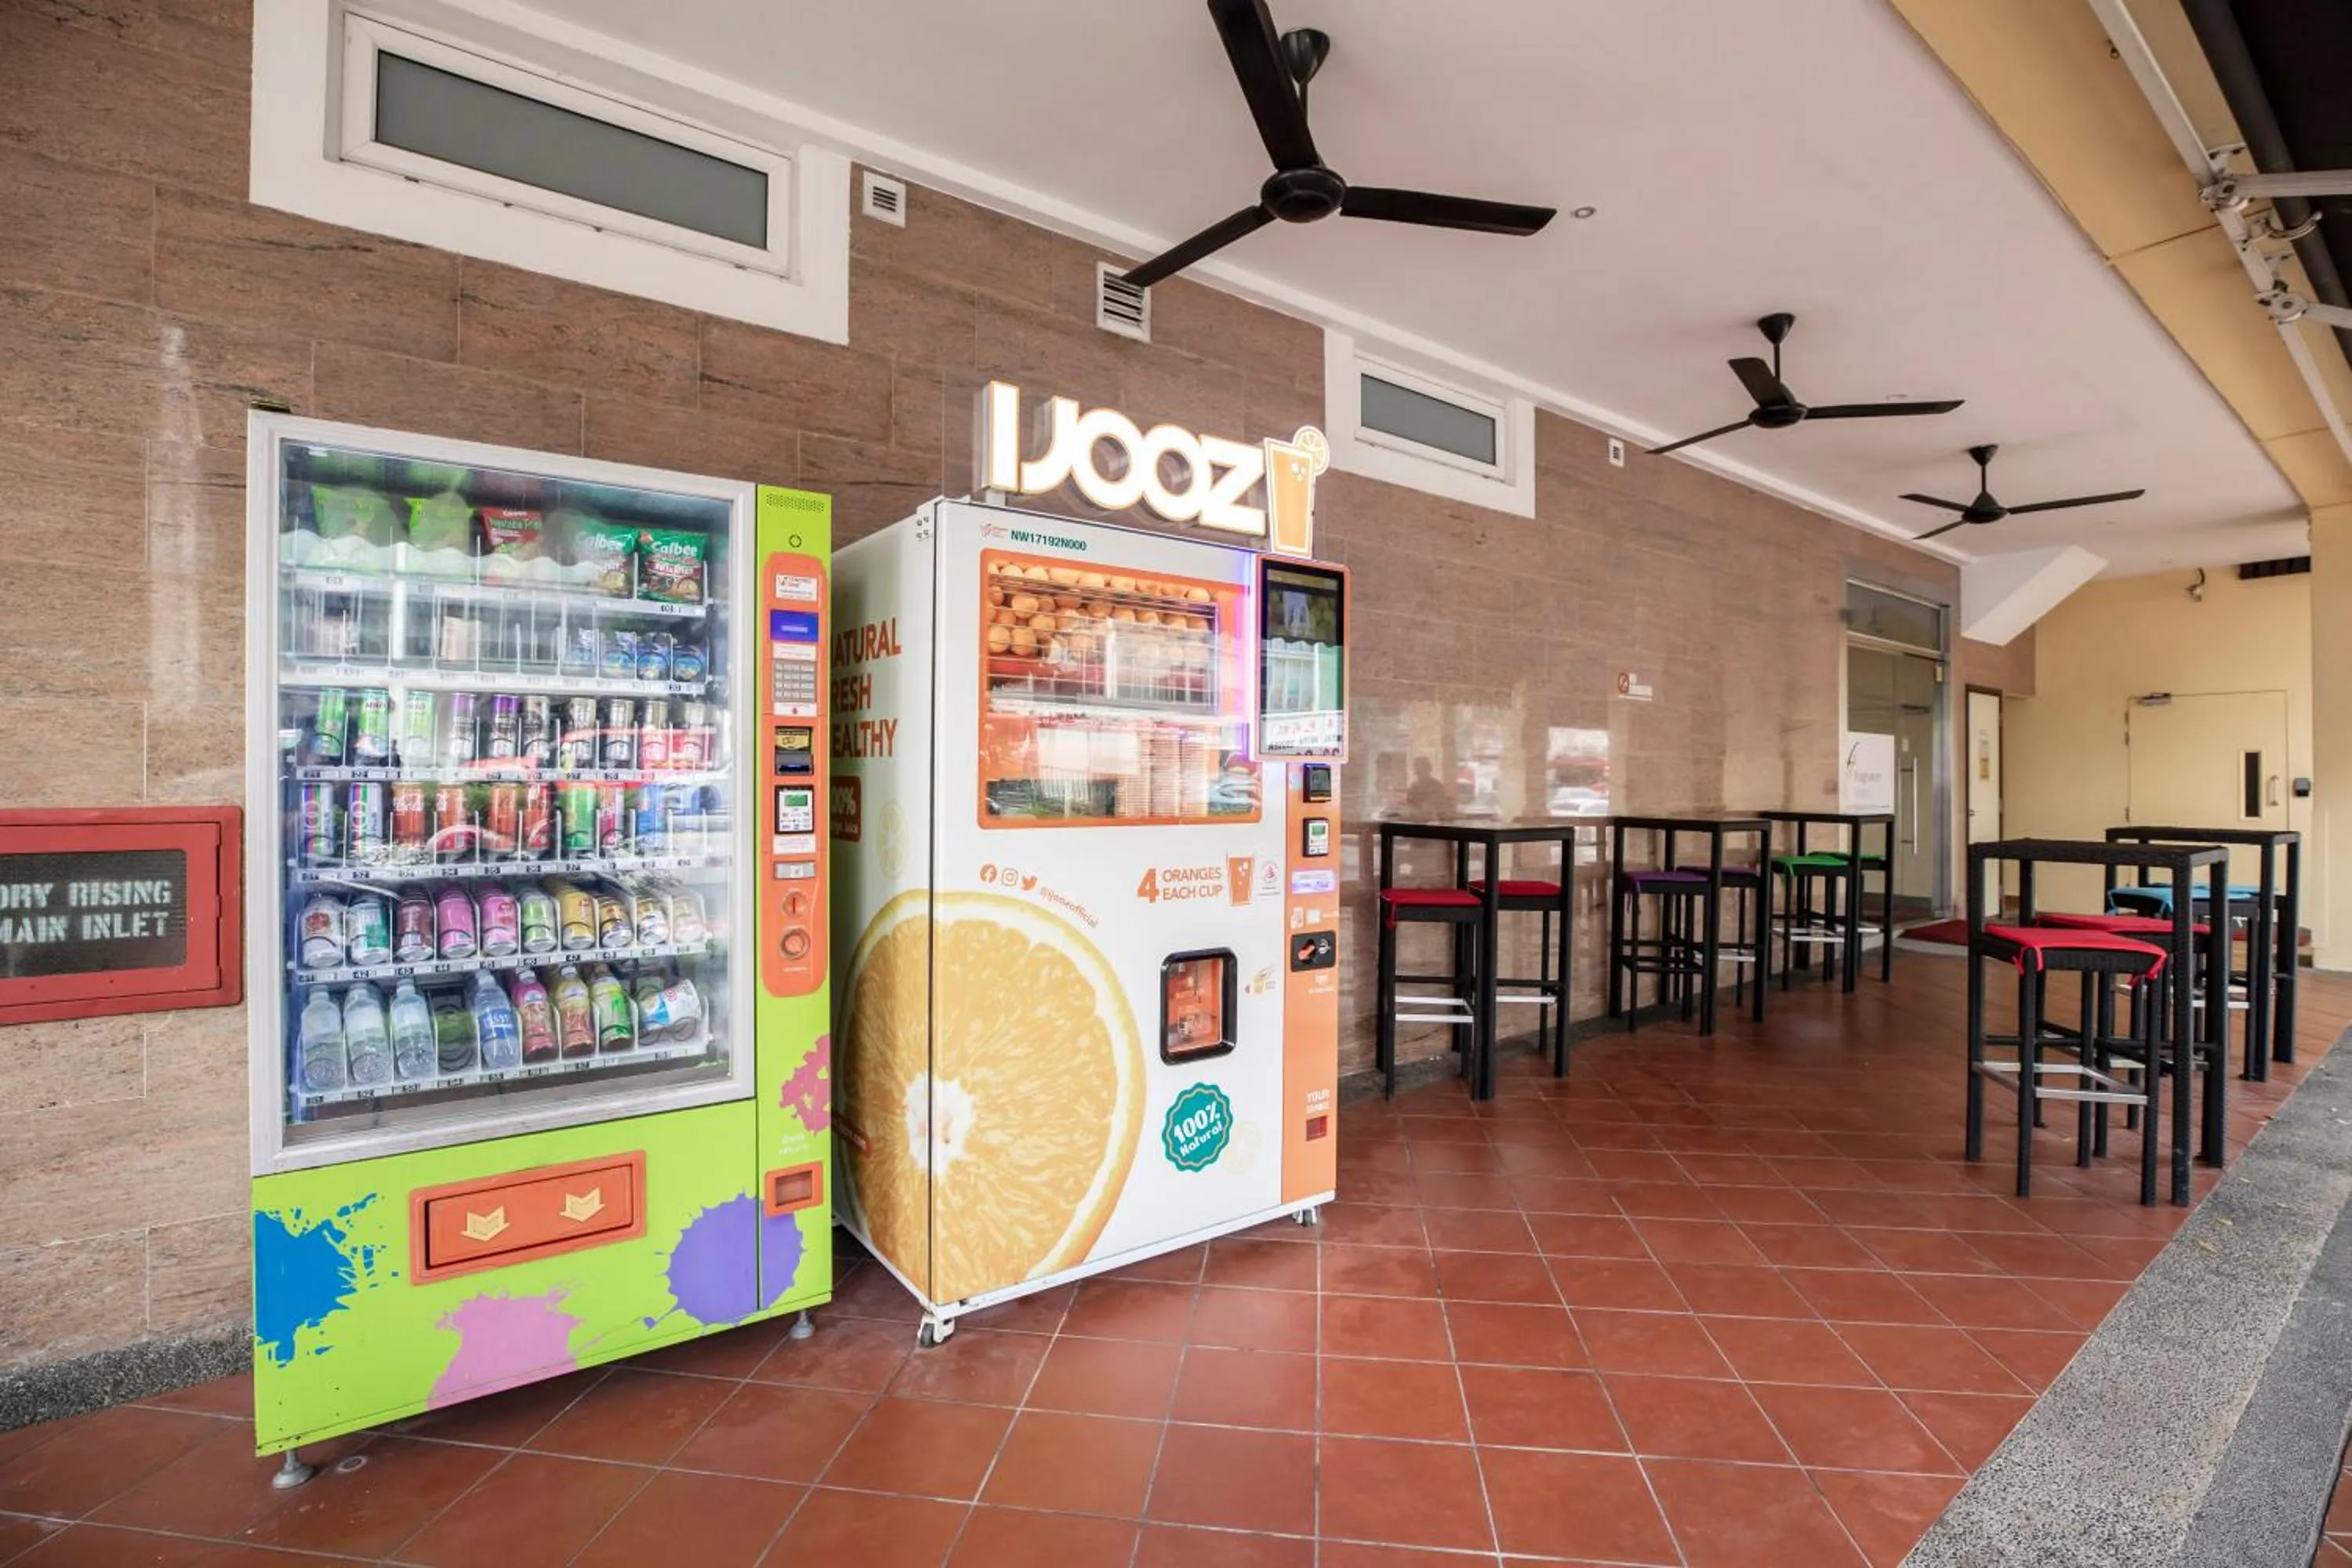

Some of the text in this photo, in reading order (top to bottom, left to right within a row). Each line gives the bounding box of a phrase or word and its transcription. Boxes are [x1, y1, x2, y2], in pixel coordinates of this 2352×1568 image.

[651, 541, 698, 557] Calbee
[1011, 529, 1087, 551] NW17192N000
[833, 617, 902, 667] ATURAL
[833, 673, 871, 712] RESH
[833, 718, 898, 758] EALTHY
[1137, 868, 1158, 903] 4
[1163, 867, 1221, 882] ORANGES
[68, 880, 172, 907] RISING
[1163, 884, 1222, 901] EACH CUP
[82, 912, 169, 940] INLET
[1174, 1101, 1221, 1144] 100%
[1179, 1121, 1223, 1156] Natural
